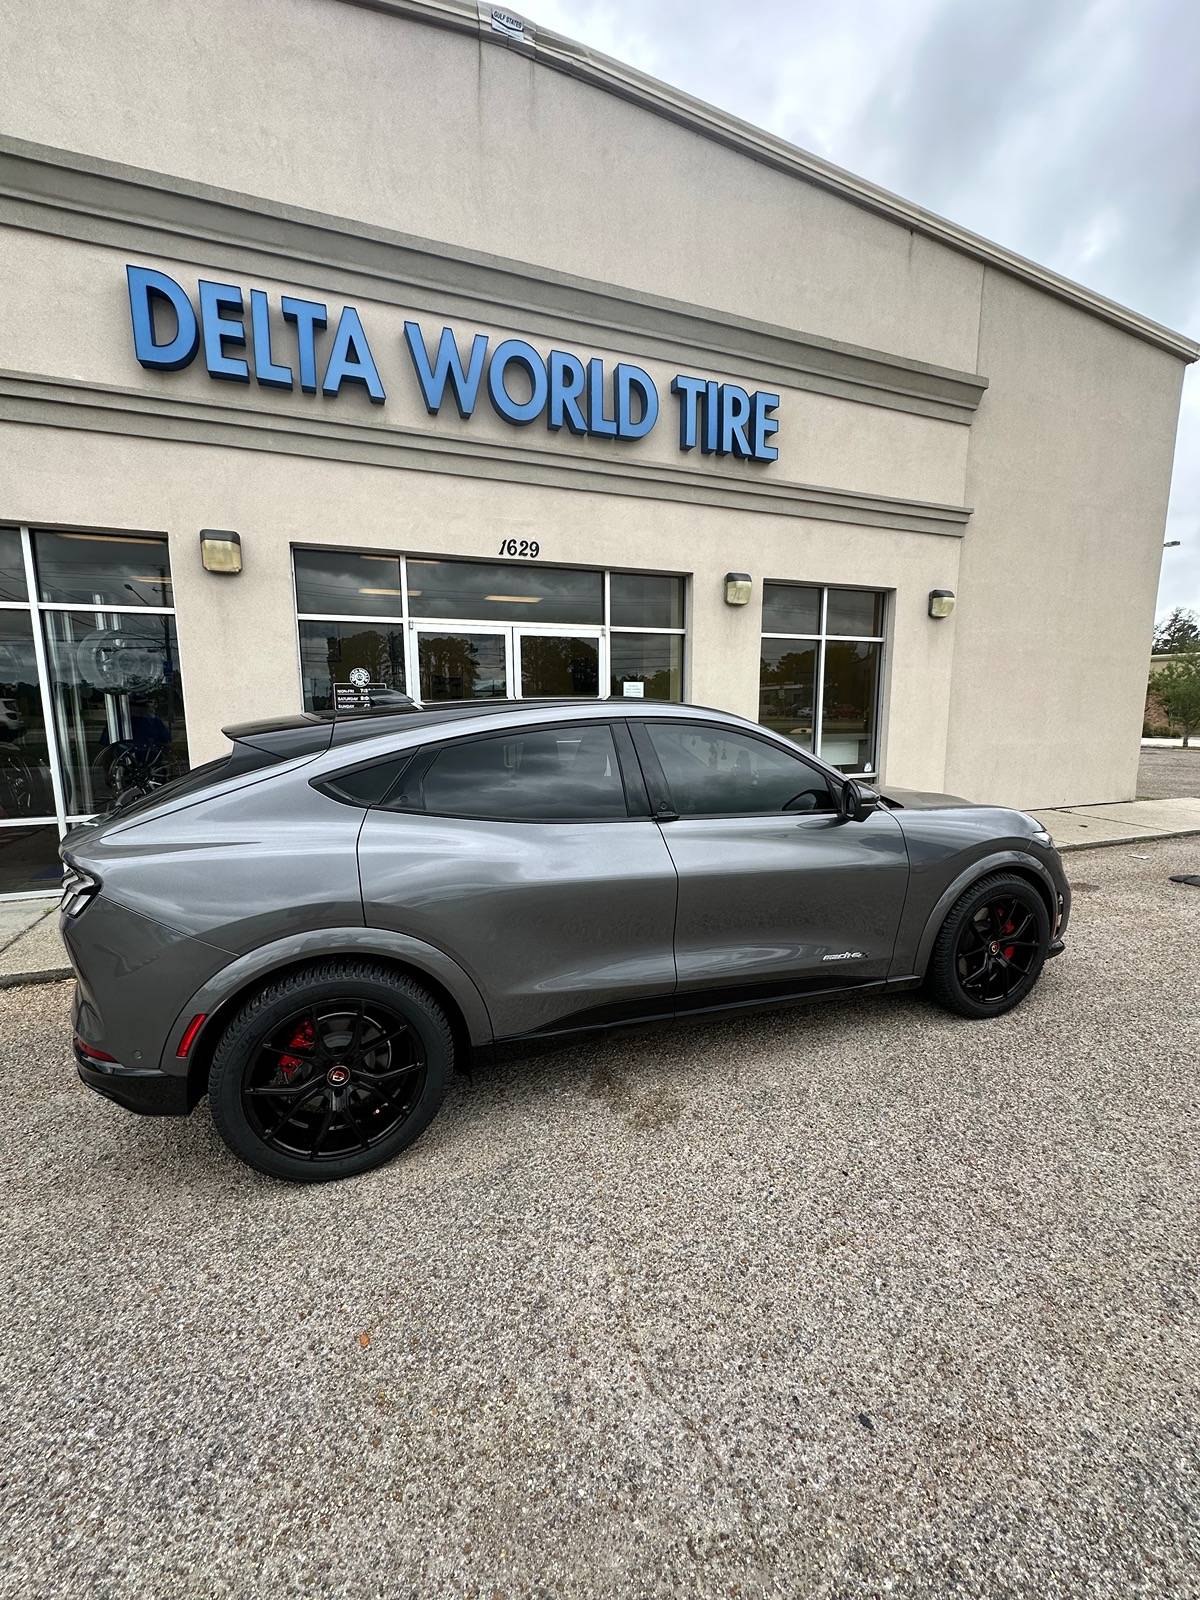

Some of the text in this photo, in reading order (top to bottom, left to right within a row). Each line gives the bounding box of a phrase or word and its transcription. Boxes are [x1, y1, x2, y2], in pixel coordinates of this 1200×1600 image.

[493, 11, 522, 28] GULF STATES
[126, 264, 780, 464] DELTA WORLD TIRE
[498, 539, 540, 558] 1629
